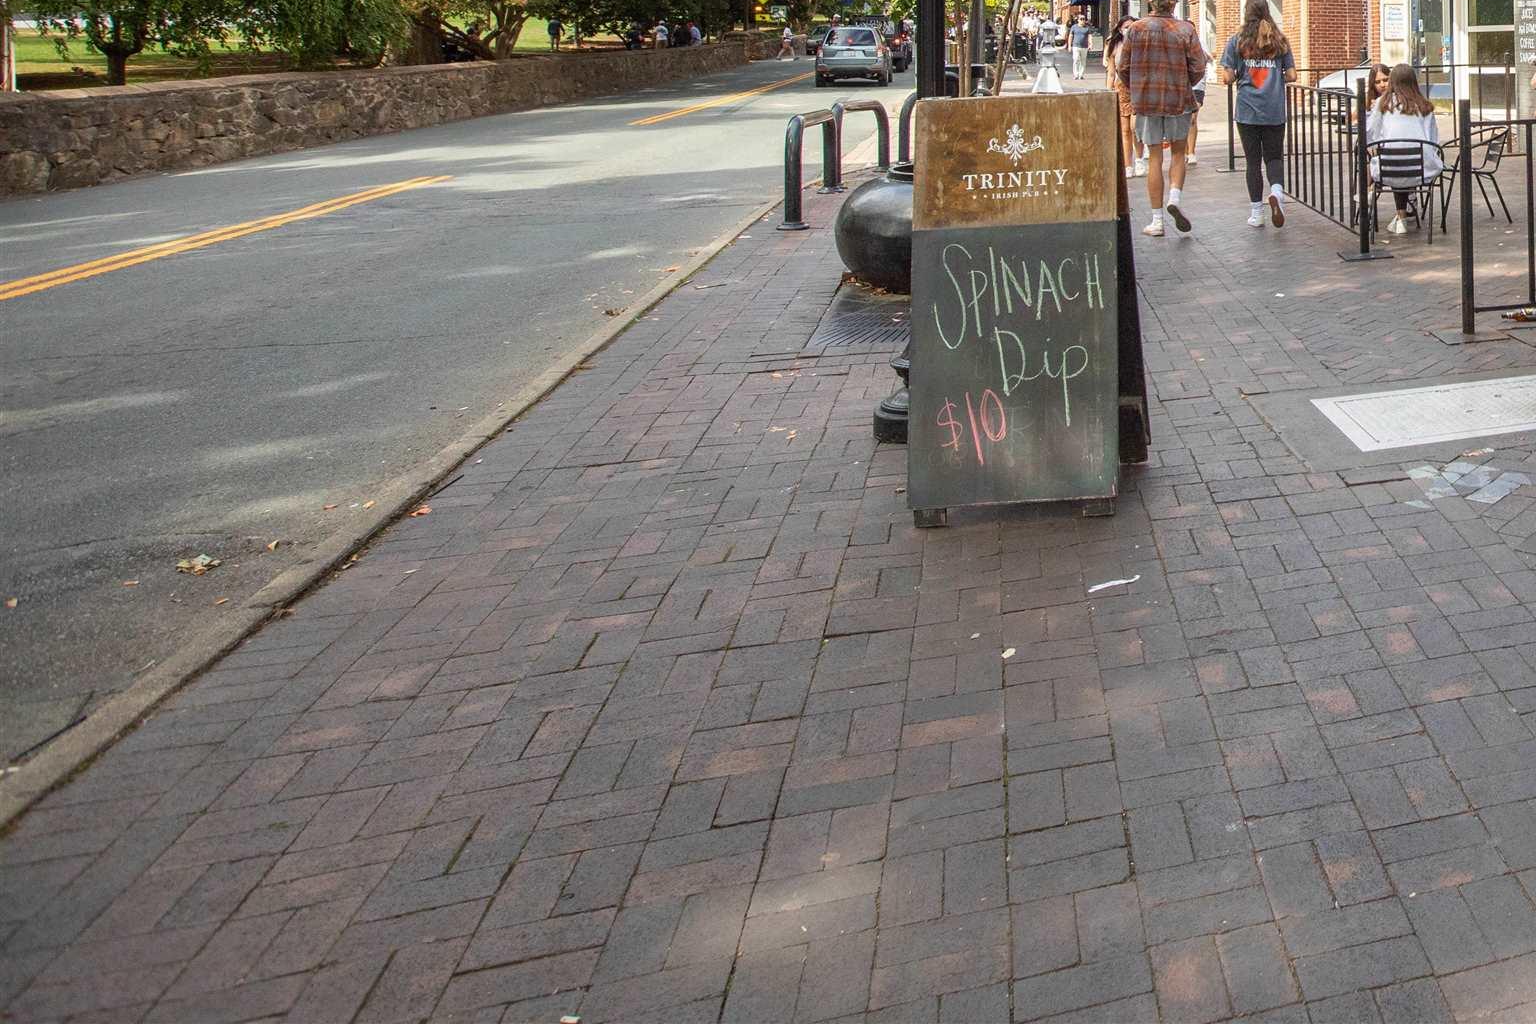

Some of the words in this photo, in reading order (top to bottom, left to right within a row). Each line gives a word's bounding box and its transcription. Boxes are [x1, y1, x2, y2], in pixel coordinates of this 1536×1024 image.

[963, 169, 1068, 190] TRINITY
[992, 192, 1018, 200] IRISH
[934, 243, 1104, 350] SPINACH
[995, 326, 1089, 427] Dip
[936, 388, 1007, 466] $10
